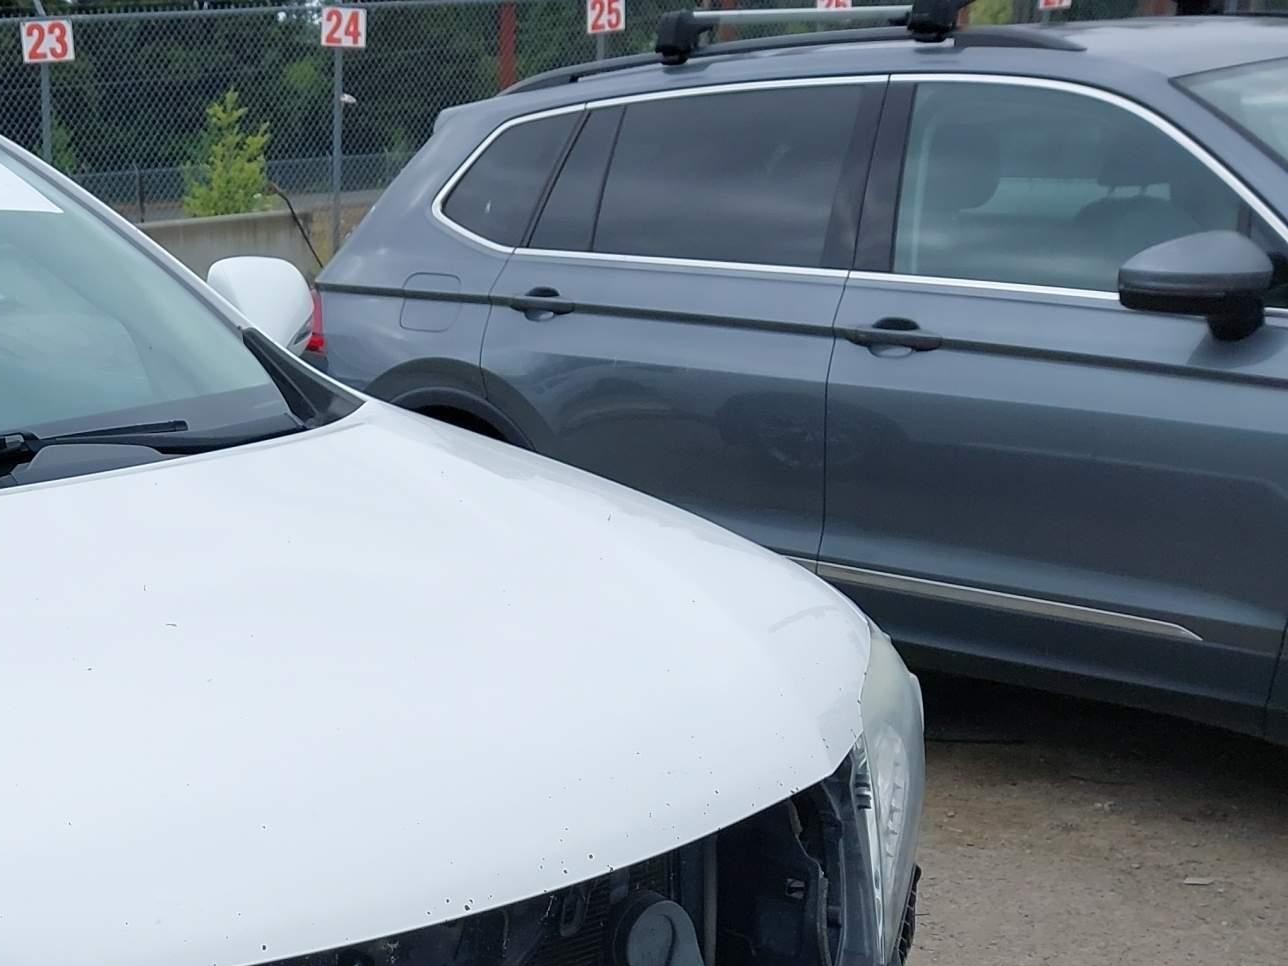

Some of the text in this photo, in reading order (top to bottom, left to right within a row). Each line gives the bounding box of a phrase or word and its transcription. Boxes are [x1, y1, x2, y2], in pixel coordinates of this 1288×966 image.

[326, 9, 361, 44] 24
[591, 0, 621, 30] 25
[26, 21, 68, 60] 23
